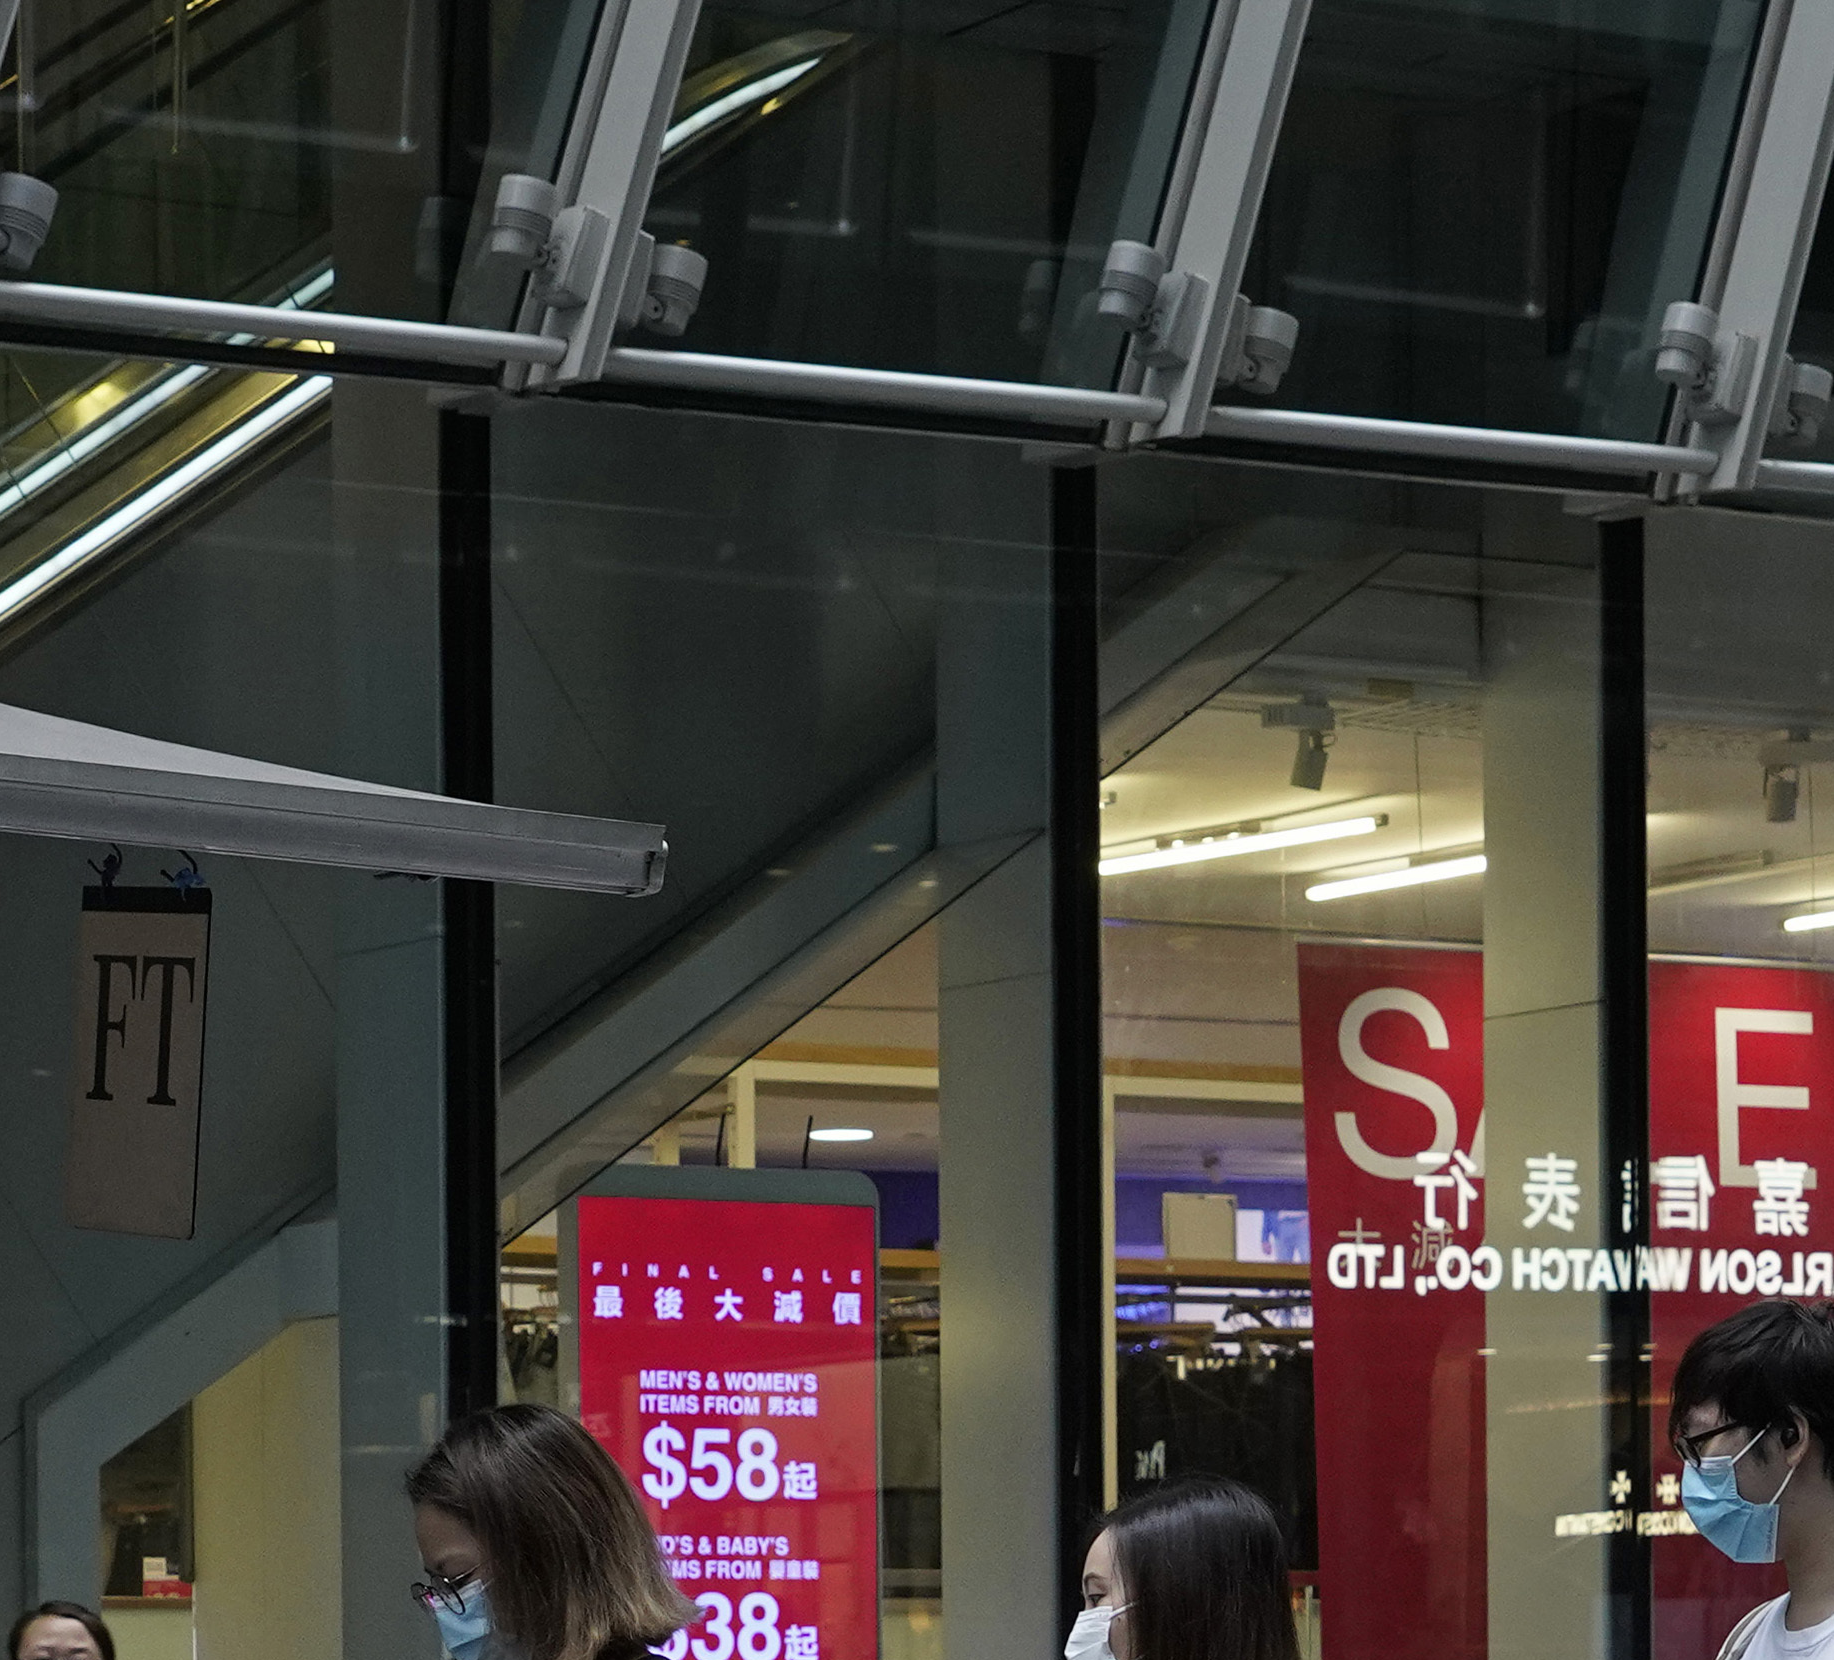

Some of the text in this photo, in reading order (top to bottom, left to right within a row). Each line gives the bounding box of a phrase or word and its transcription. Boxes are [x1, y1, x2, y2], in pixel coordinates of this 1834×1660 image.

[85, 954, 196, 1107] FT
[1334, 986, 1816, 1190] SE
[592, 1261, 862, 1284] FINAL SALE
[593, 1284, 862, 1325] 最後大減價
[639, 1370, 818, 1393] MEN'S & WOMEN'S
[639, 1395, 700, 1415] ITEMS
[703, 1396, 760, 1415] FROM
[641, 1421, 818, 1508] $58 起
[657, 1535, 789, 1556] D'S & BABY'S
[705, 1560, 762, 1580] FROM
